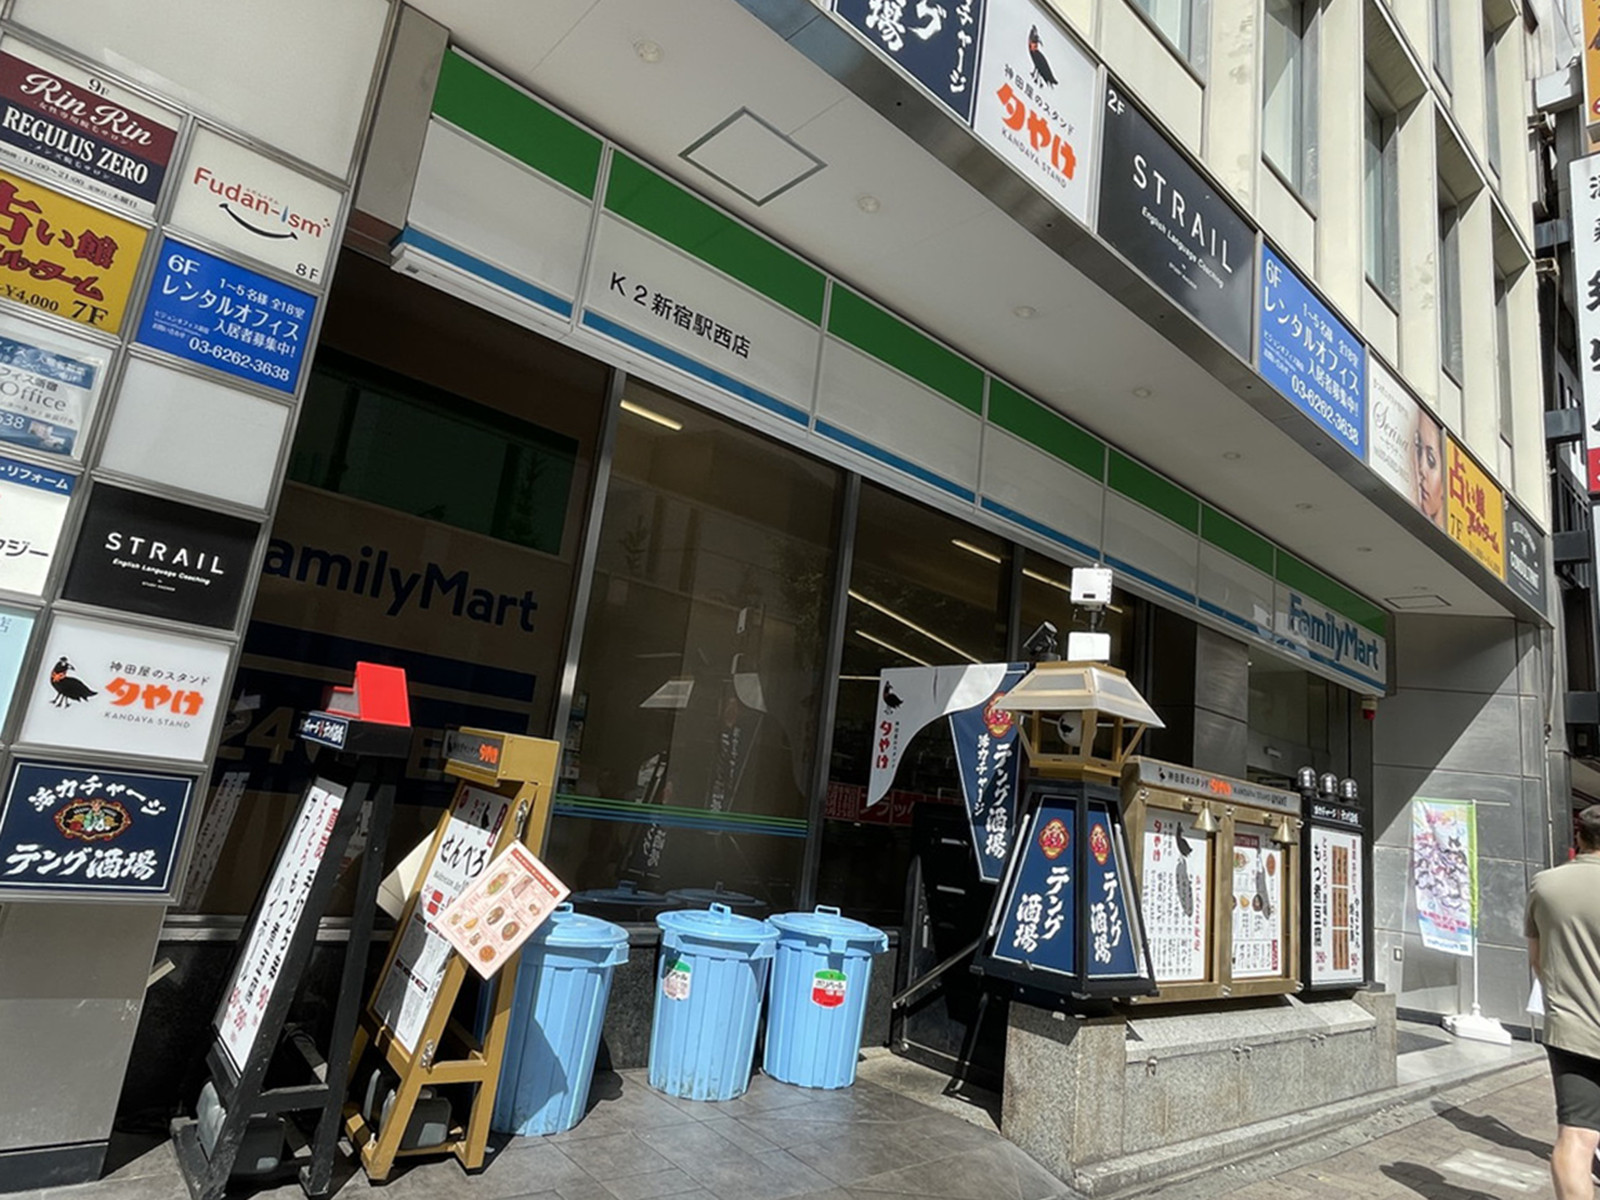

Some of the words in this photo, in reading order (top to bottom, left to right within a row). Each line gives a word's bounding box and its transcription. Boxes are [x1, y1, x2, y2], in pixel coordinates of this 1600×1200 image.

[20, 73, 87, 117] Rin
[90, 105, 152, 146] Rin
[89, 78, 110, 95] 9F
[1004, 62, 1076, 136] 神田屋のスタンド
[1108, 89, 1126, 116] 2F
[2, 105, 95, 162] REGULUS
[96, 147, 149, 185] ZERO
[996, 82, 1077, 181] 夕やけ
[1001, 127, 1040, 166] KANDAYA
[1132, 153, 1233, 275] STRAIL
[167, 254, 201, 276] 6F
[1141, 205, 1167, 236] English
[1167, 229, 1198, 264] Language
[1197, 257, 1225, 289] Coaching
[1264, 258, 1282, 288] 6F
[71, 299, 110, 326] 7F
[161, 274, 300, 342] レンタルオフィス
[188, 335, 290, 382] 03-6262-3638
[1264, 285, 1360, 396] レンタルオフィス
[1449, 444, 1486, 520] 占い館
[104, 531, 225, 576] STRAIL
[112, 557, 140, 569] English
[141, 564, 178, 578] Language
[178, 571, 212, 586] Coaching
[262, 536, 538, 632] amilyMart
[1288, 591, 1380, 672] FamilyMart
[104, 676, 204, 717] 夕やけ
[109, 659, 211, 686] 神田屋のスタンド
[103, 711, 154, 725] KANDAYA
[157, 717, 190, 729] STAND
[985, 742, 1013, 859] テング酒場
[2, 843, 158, 881] テング酒場
[440, 833, 488, 879] せんべろ
[1013, 893, 1044, 953] 酒場
[1041, 866, 1071, 940] テング
[1090, 902, 1112, 964] 酒場
[1102, 871, 1123, 947] テング
